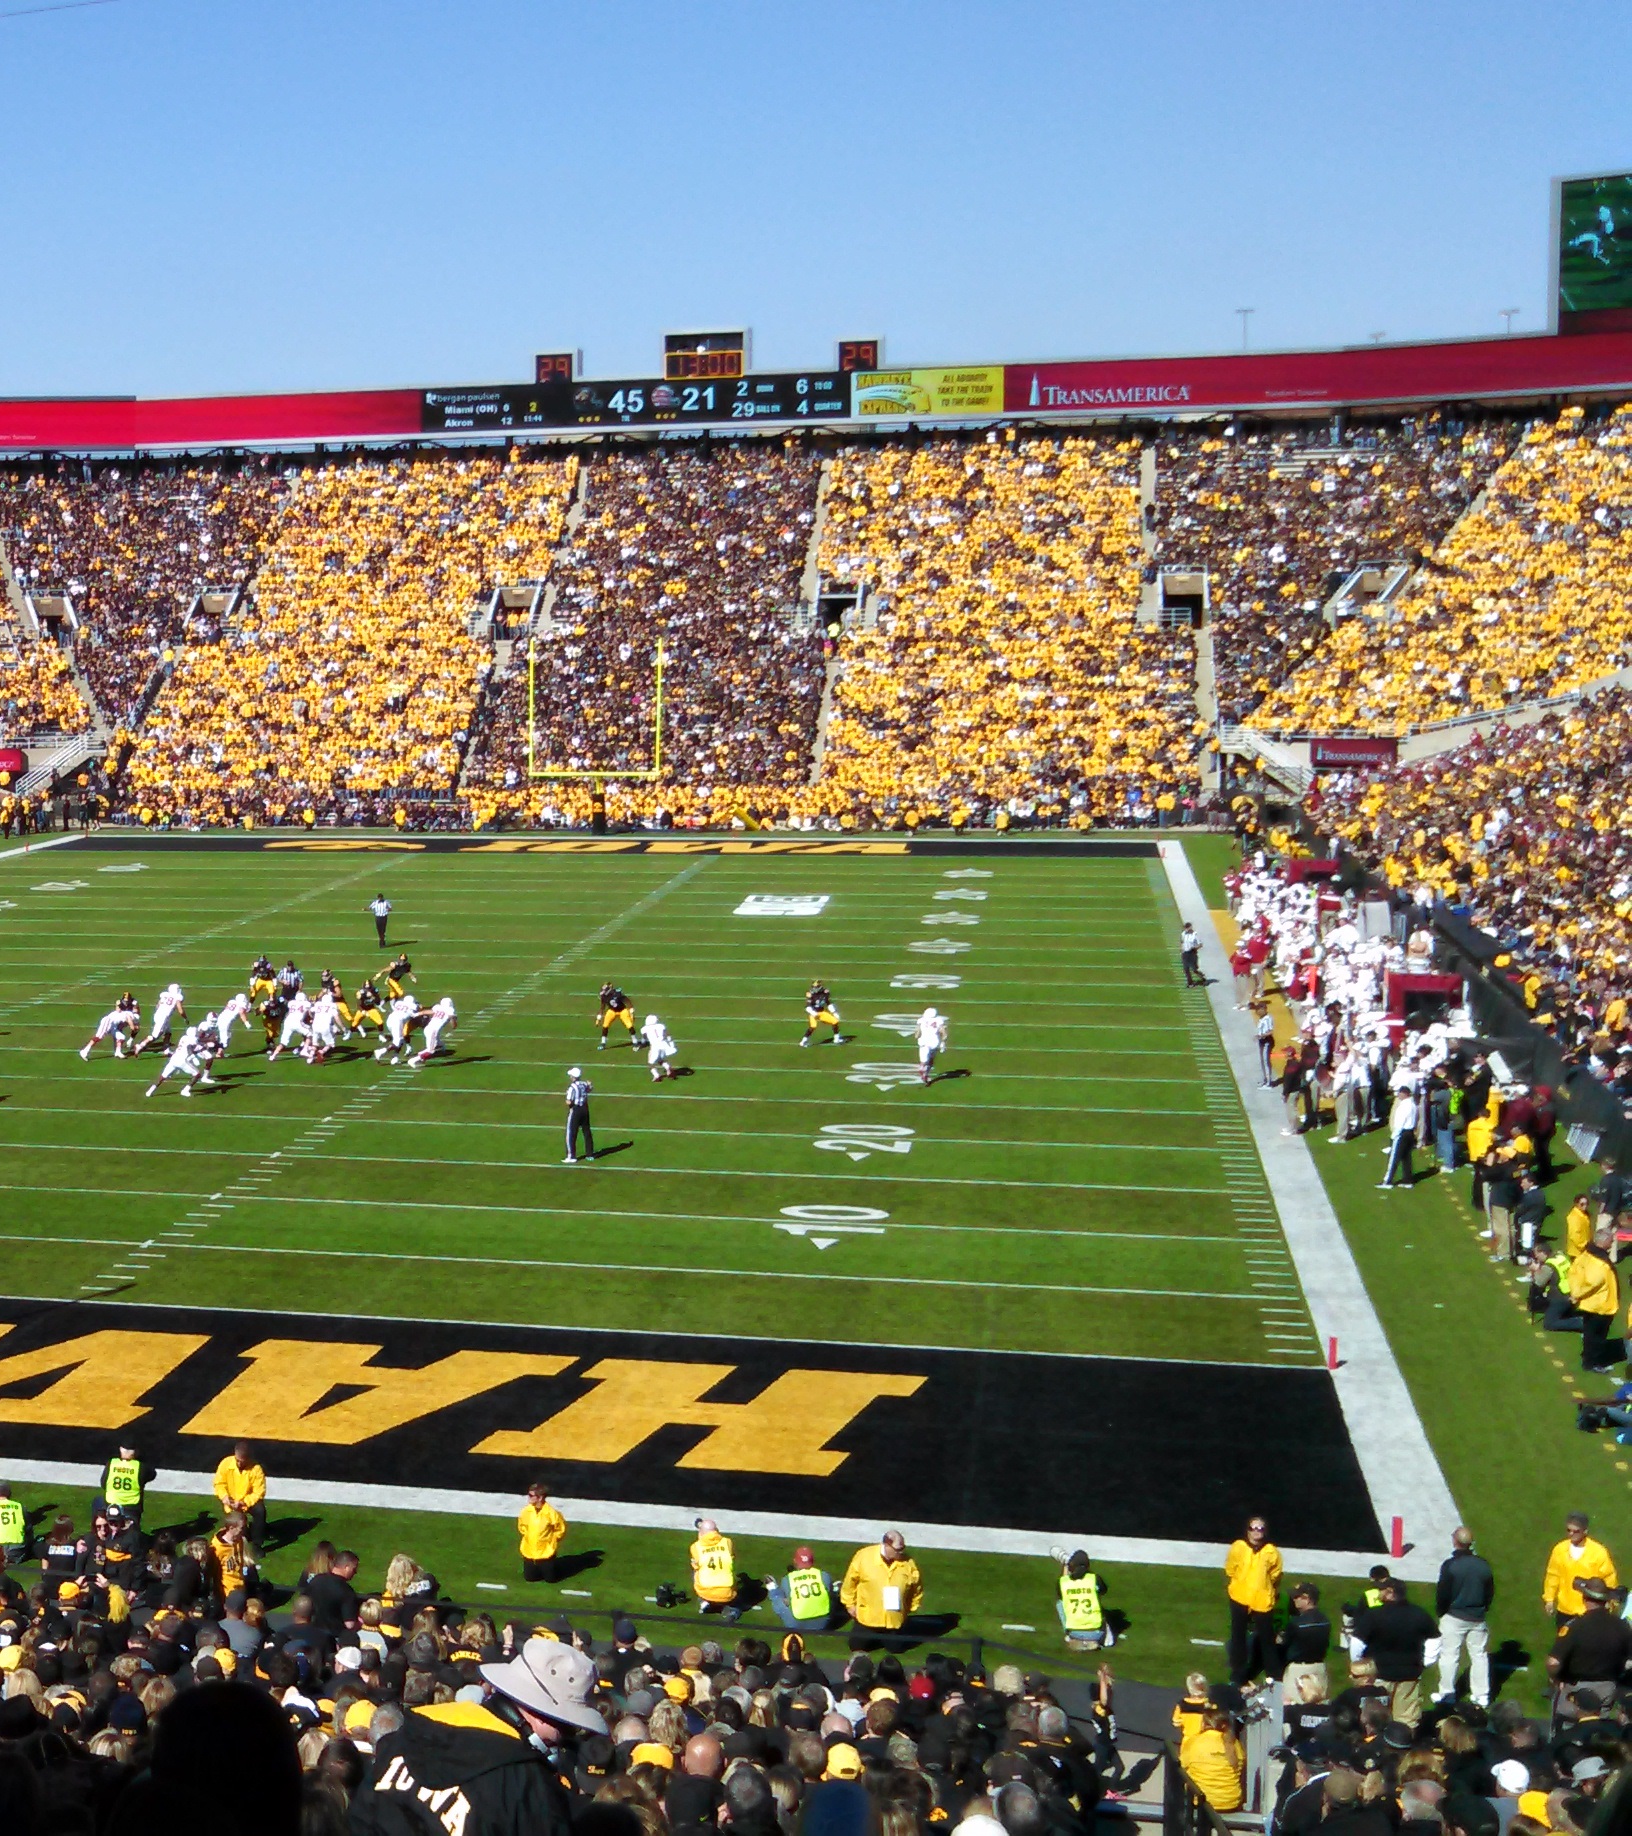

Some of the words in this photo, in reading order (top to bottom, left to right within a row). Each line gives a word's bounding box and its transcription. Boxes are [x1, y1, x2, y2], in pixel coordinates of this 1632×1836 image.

[736, 381, 749, 397] 2
[795, 378, 809, 395] 6
[608, 388, 645, 414] 45
[681, 386, 716, 411] 21
[1043, 385, 1191, 406] TRANSAMERICA
[444, 405, 474, 415] Miami
[475, 403, 498, 415] (OH)
[731, 401, 755, 418] 29
[796, 399, 809, 415] 4
[444, 418, 474, 428] Akron
[500, 416, 513, 426] 12
[459, 840, 912, 855] IOWA
[844, 1062, 936, 1085] 30
[812, 1124, 917, 1154] 20
[772, 1204, 891, 1236] 10
[112, 1466, 135, 1475] PHOTO
[112, 1476, 132, 1491] 86
[0, 1511, 18, 1526] 61
[707, 1556, 723, 1571] 41
[1070, 1598, 1093, 1615] 73
